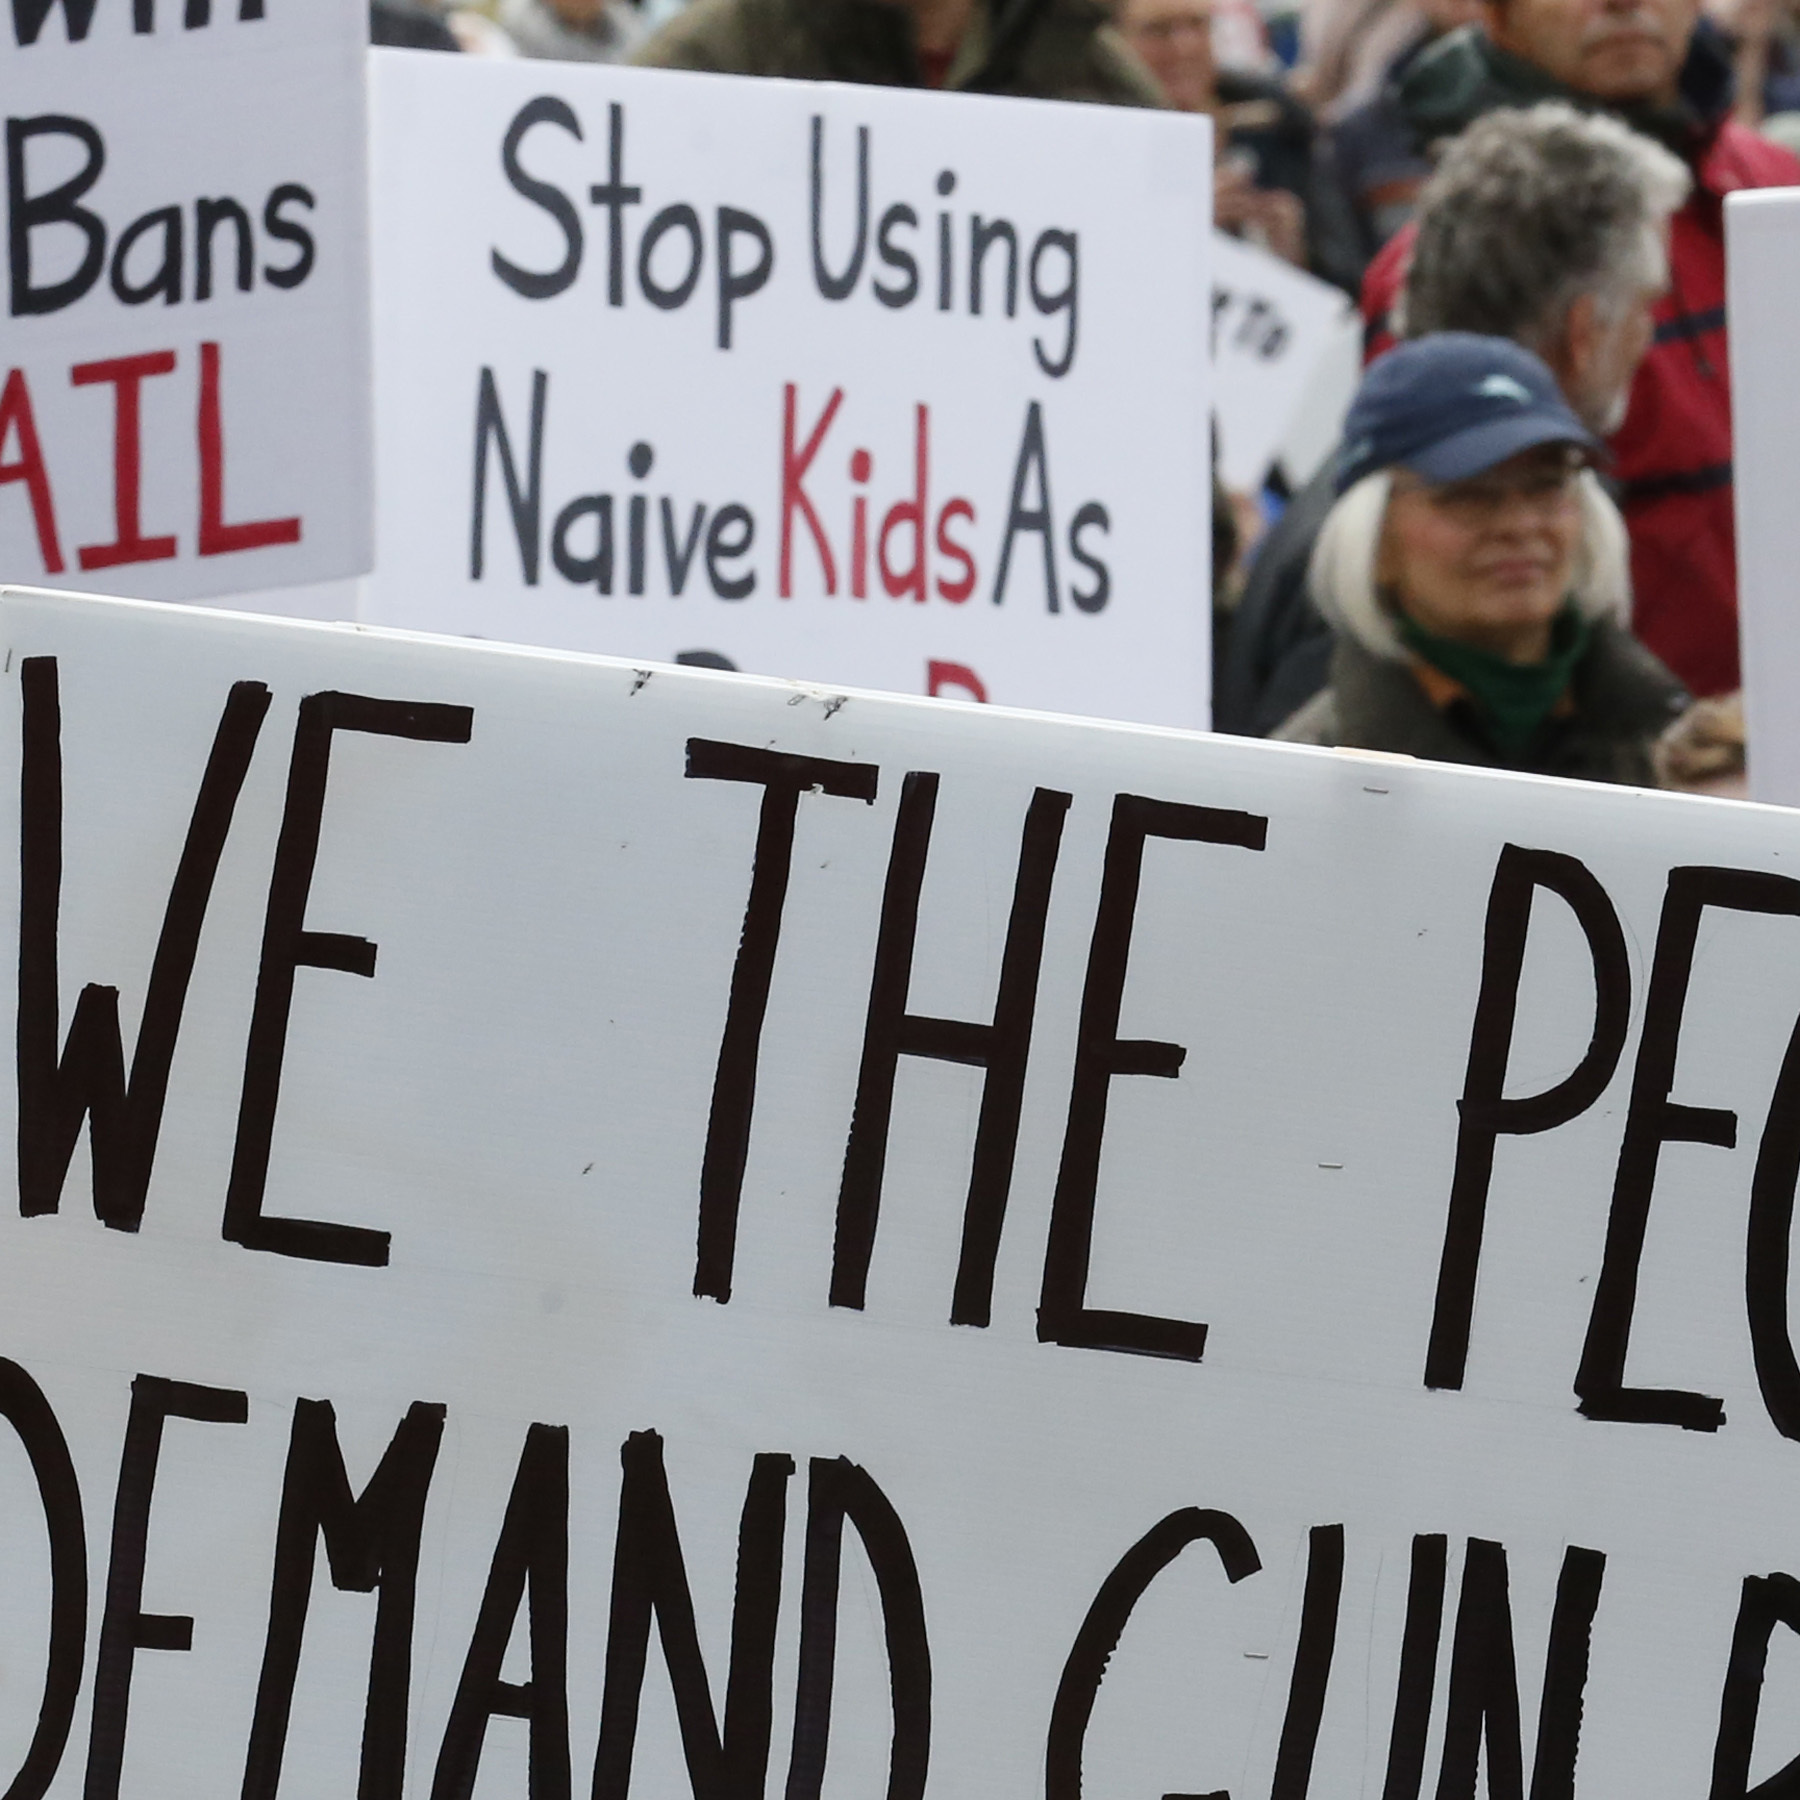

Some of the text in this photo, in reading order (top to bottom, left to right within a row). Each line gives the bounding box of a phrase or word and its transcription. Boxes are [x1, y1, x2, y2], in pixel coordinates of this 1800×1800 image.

[6, 114, 314, 317] Bans
[491, 95, 1079, 380] Stop Using
[470, 366, 1111, 614] Naive Kids As
[16, 656, 474, 1268] WE
[684, 737, 1269, 1364] THE
